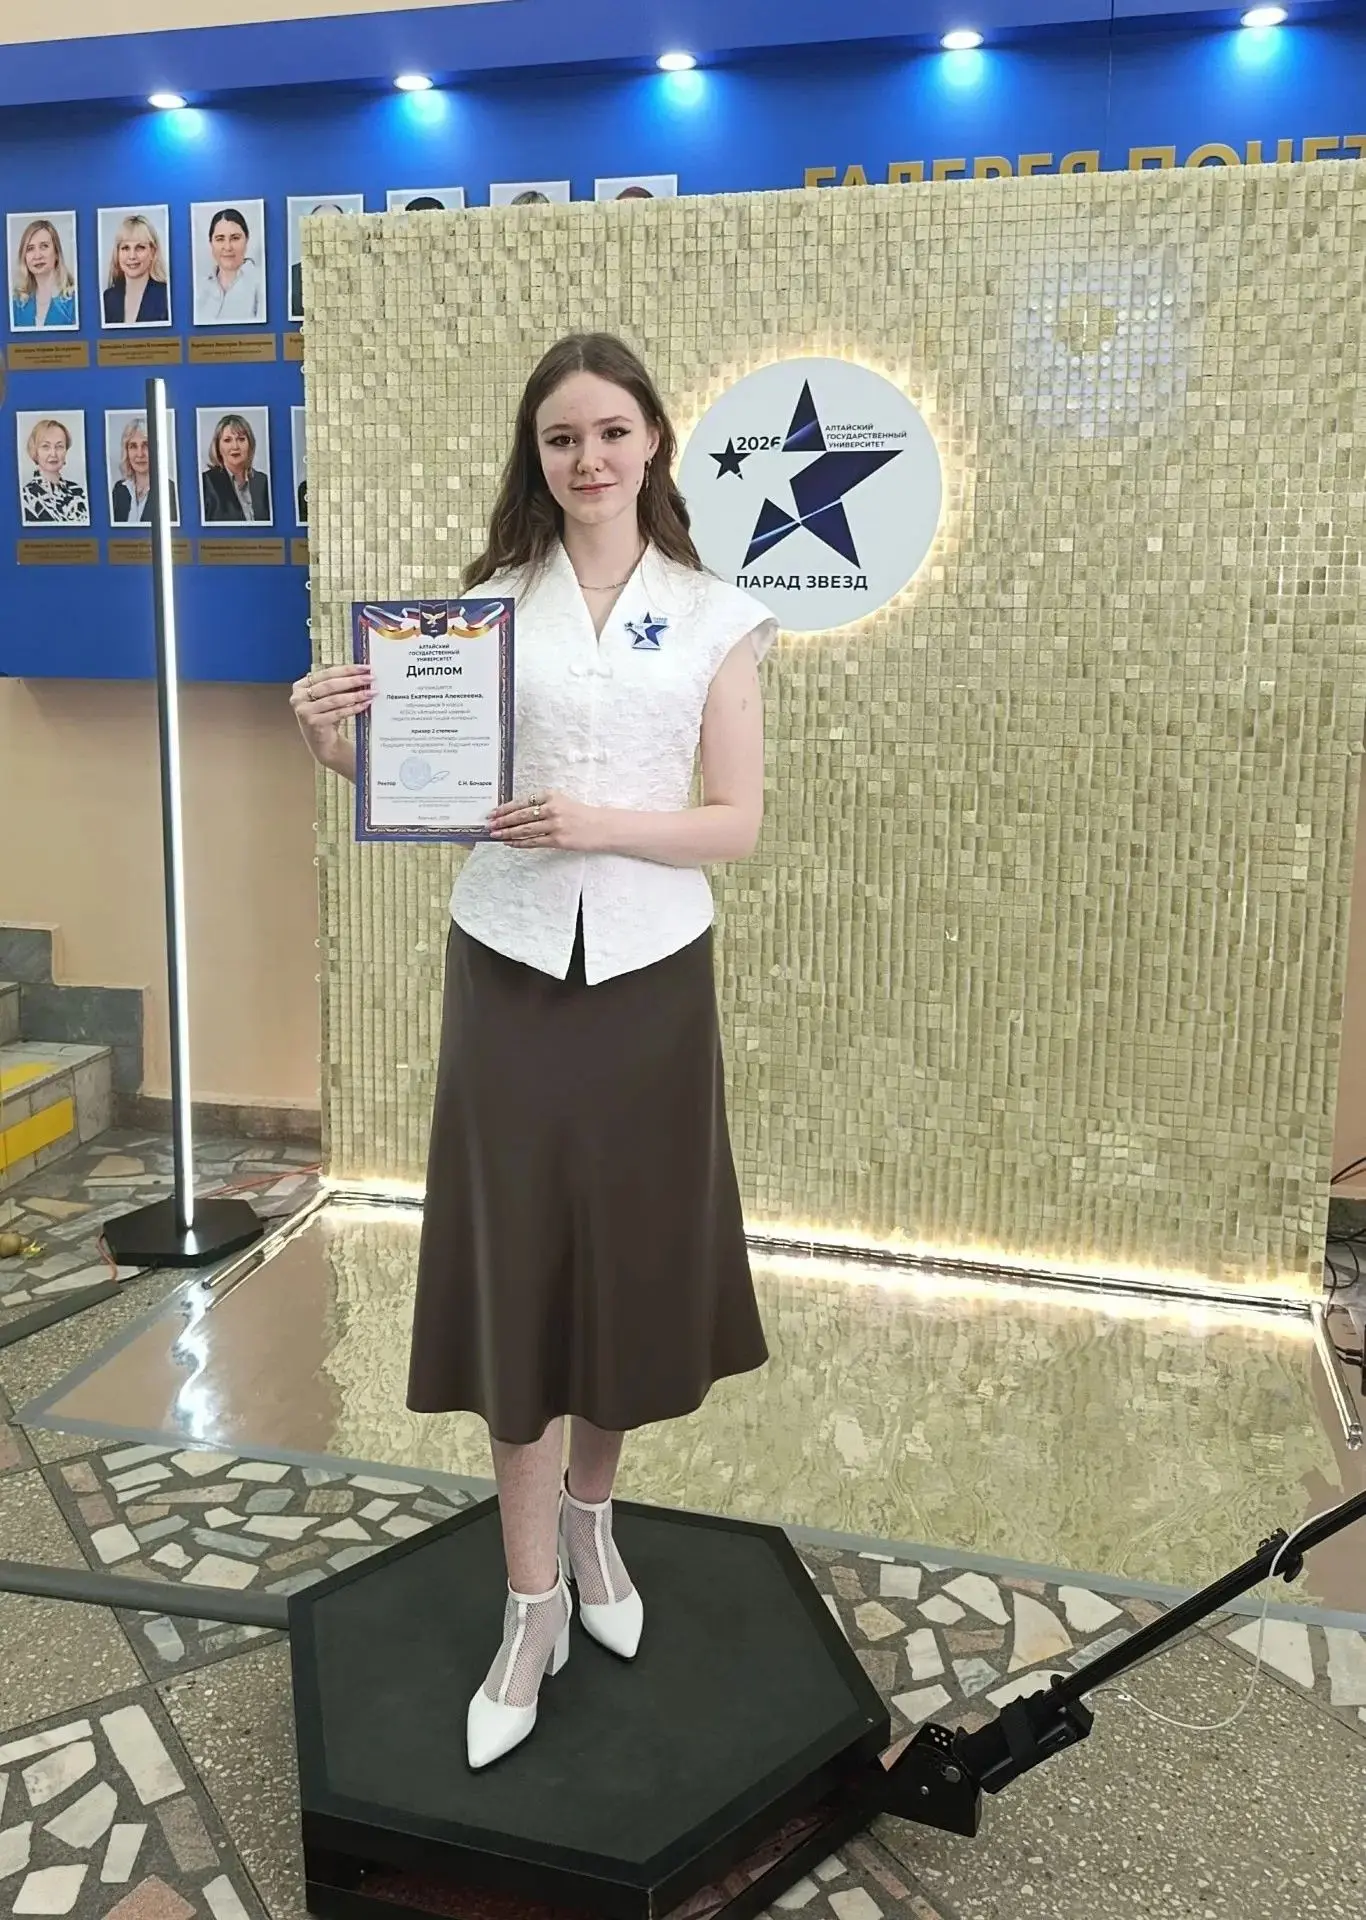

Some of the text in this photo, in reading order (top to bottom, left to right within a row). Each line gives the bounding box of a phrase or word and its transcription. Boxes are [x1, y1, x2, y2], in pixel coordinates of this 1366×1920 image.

[825, 423, 874, 431] АЛТАЙСКИЙ
[826, 431, 907, 440] ГОСУДАРСТВЕННЫЙ
[736, 575, 868, 590] ПАРАД ЗВЕЗД
[406, 665, 462, 678] Диплом
